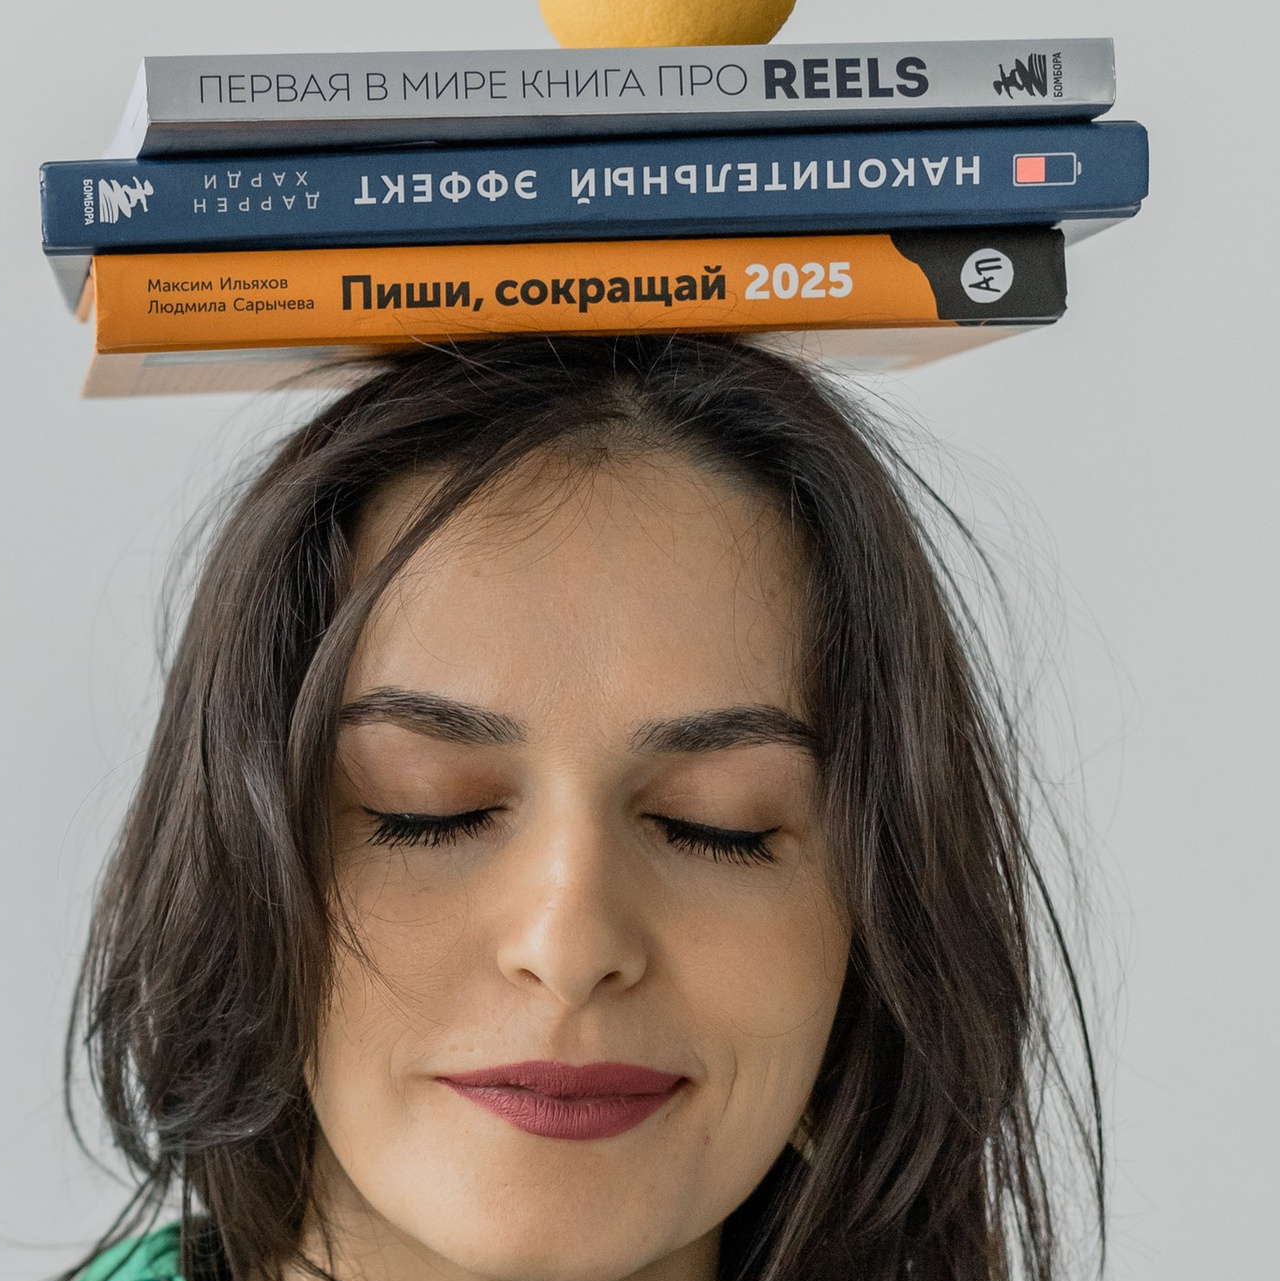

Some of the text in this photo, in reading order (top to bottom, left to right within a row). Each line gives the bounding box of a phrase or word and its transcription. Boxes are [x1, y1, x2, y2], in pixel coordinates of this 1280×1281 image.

[199, 56, 930, 104] ПЕРВАЯ В МИРЕ КНИГА ПРО REELS
[1053, 51, 1064, 98] БОМБОРА
[82, 178, 95, 226] БОМБОРА
[193, 191, 320, 213] ДАРРЕН
[204, 170, 308, 190] ХАРДИ
[354, 155, 980, 205] НАКОПИТЕЛЬНЫЙ ЭФФЕКТ
[147, 276, 288, 293] Максим Ильяхов
[147, 297, 315, 316] Людмила Сарычева
[341, 261, 853, 314] Пиши, сокращай 2025
